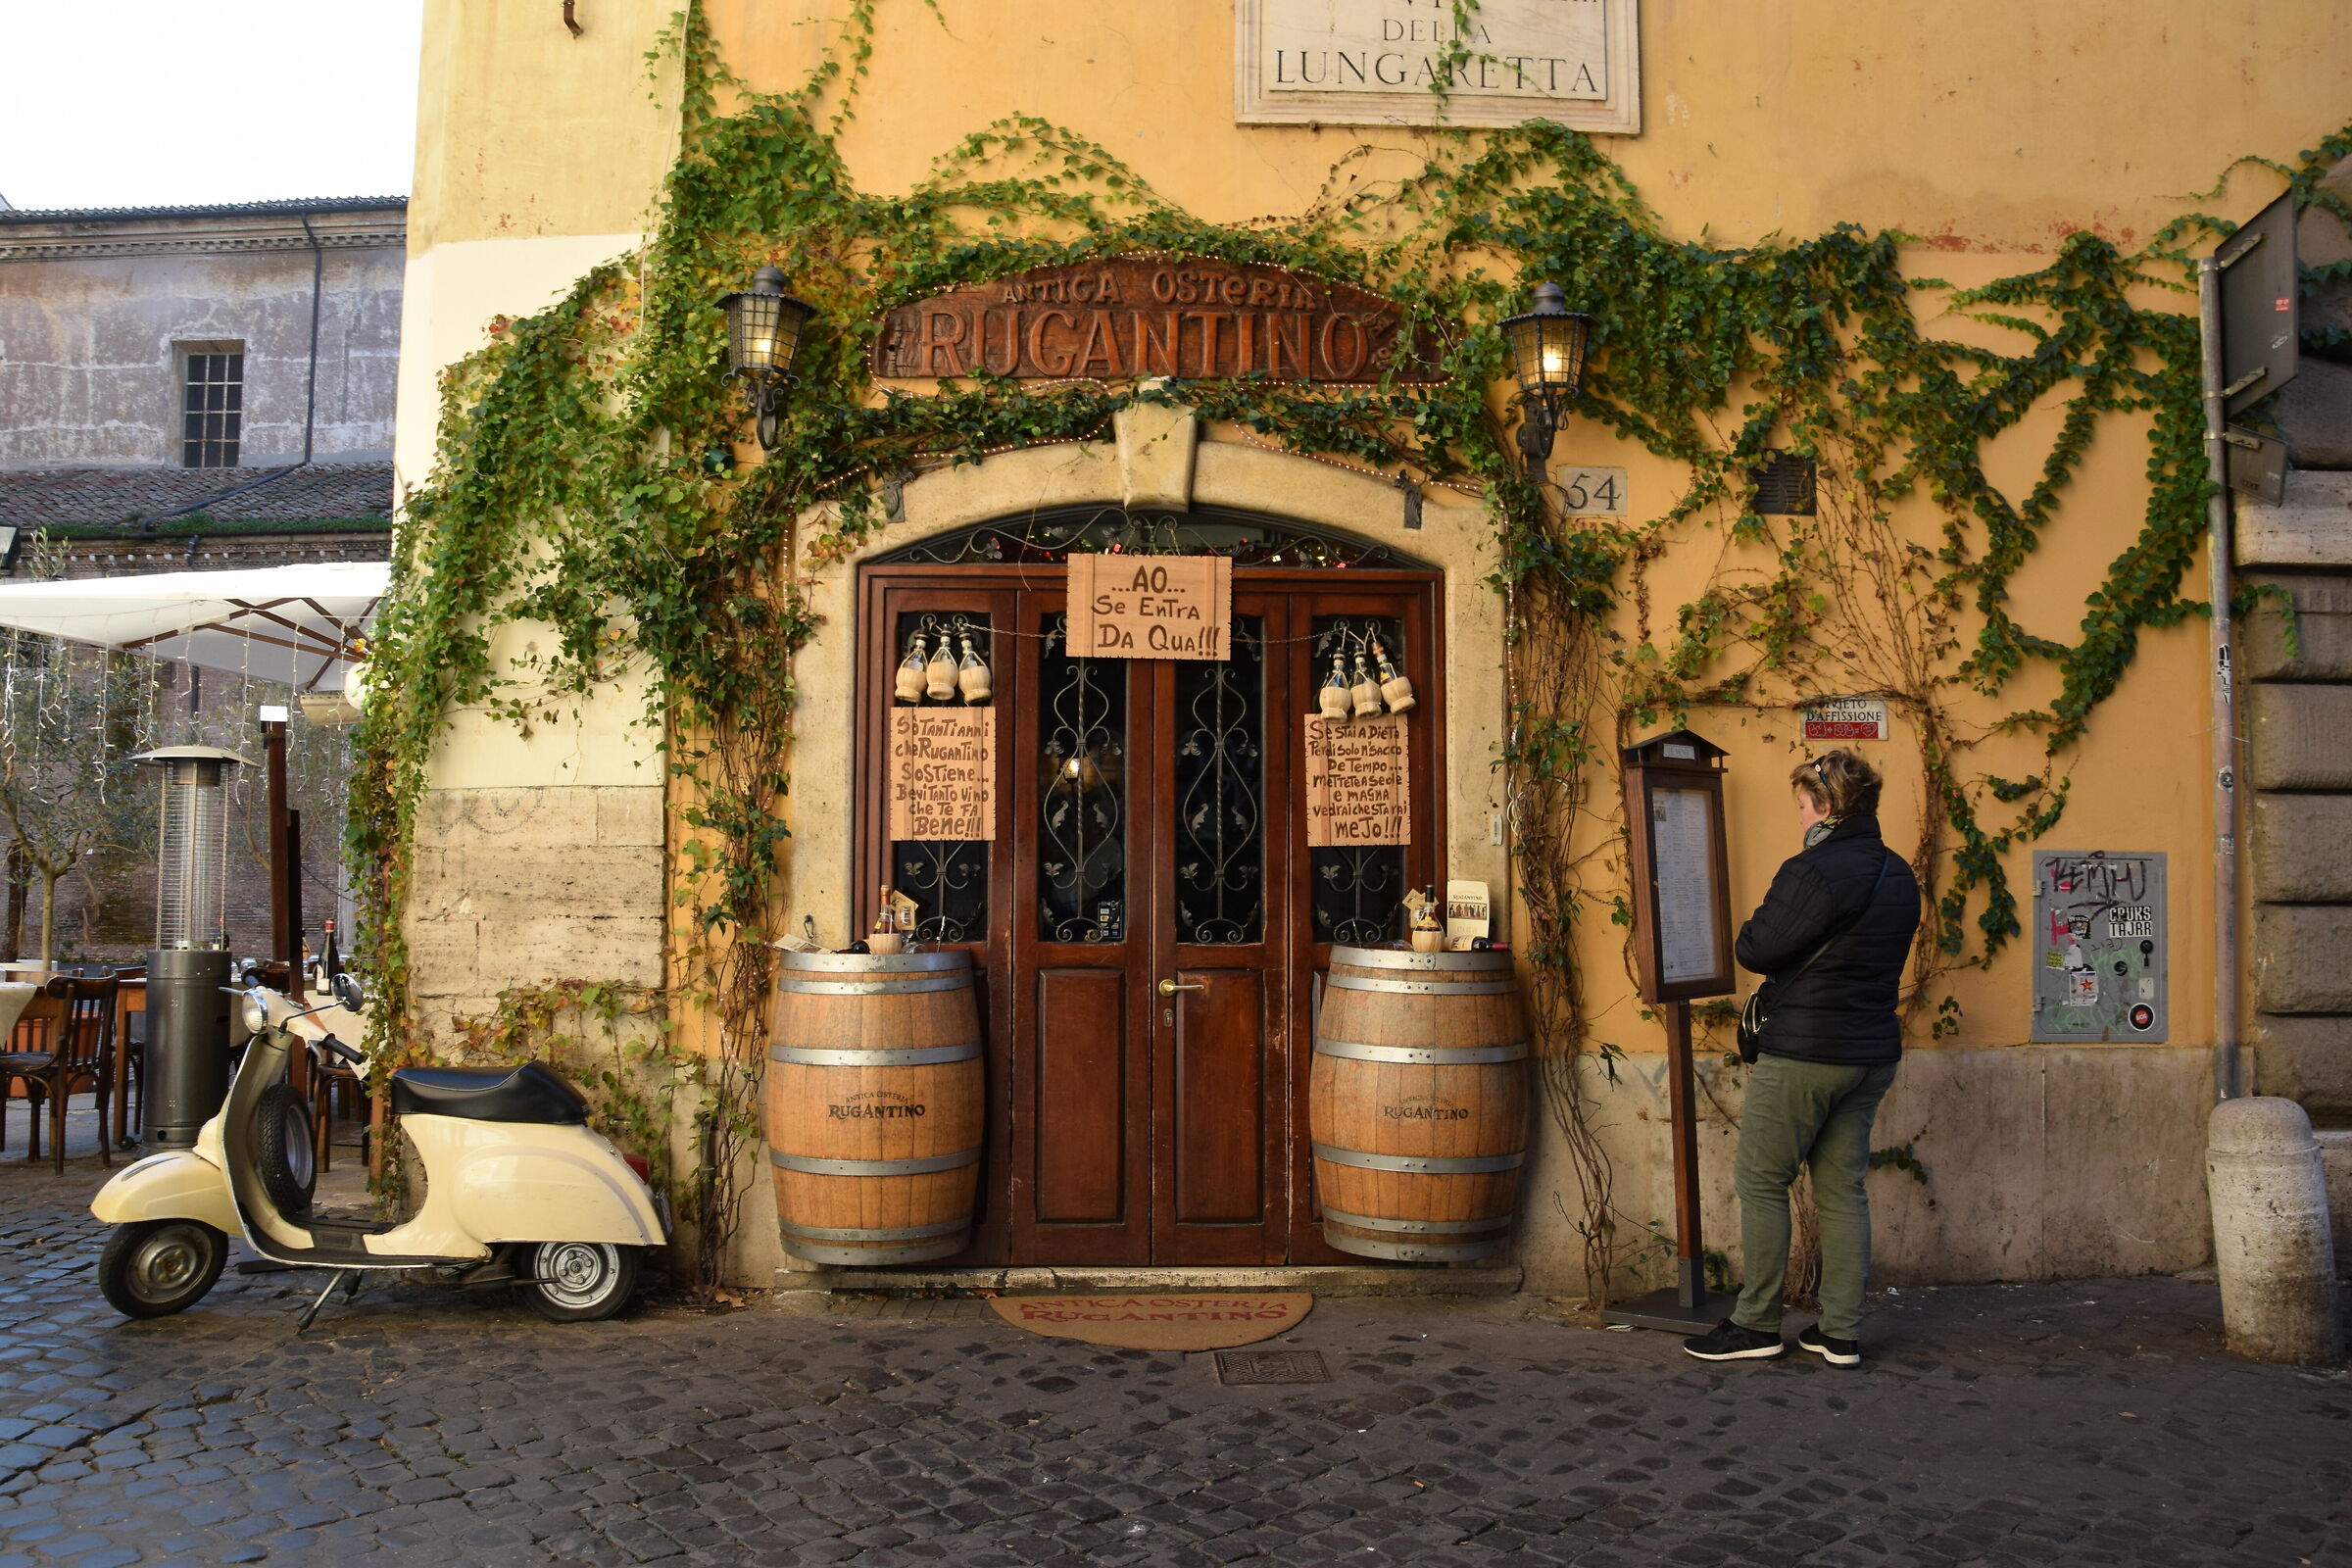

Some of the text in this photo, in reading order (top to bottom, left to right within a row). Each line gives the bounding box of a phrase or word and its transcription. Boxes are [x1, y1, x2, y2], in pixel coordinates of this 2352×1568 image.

[1275, 50, 1599, 93] LUNGARETTA
[1003, 270, 1124, 305] ANTICA
[917, 308, 1369, 380] RUGANTINO
[1567, 472, 1622, 511] 54
[1091, 595, 1126, 615] Se
[1308, 719, 1333, 740] Se
[908, 801, 934, 815] che
[846, 1091, 908, 1104] ANTICA OSTERIA
[828, 1102, 926, 1120] RUGANTINO
[1383, 1104, 1469, 1120] RUGANTINO
[1018, 1298, 1289, 1310] ANTICA OSTERIA
[1022, 1310, 1288, 1323] RUGANTINO
